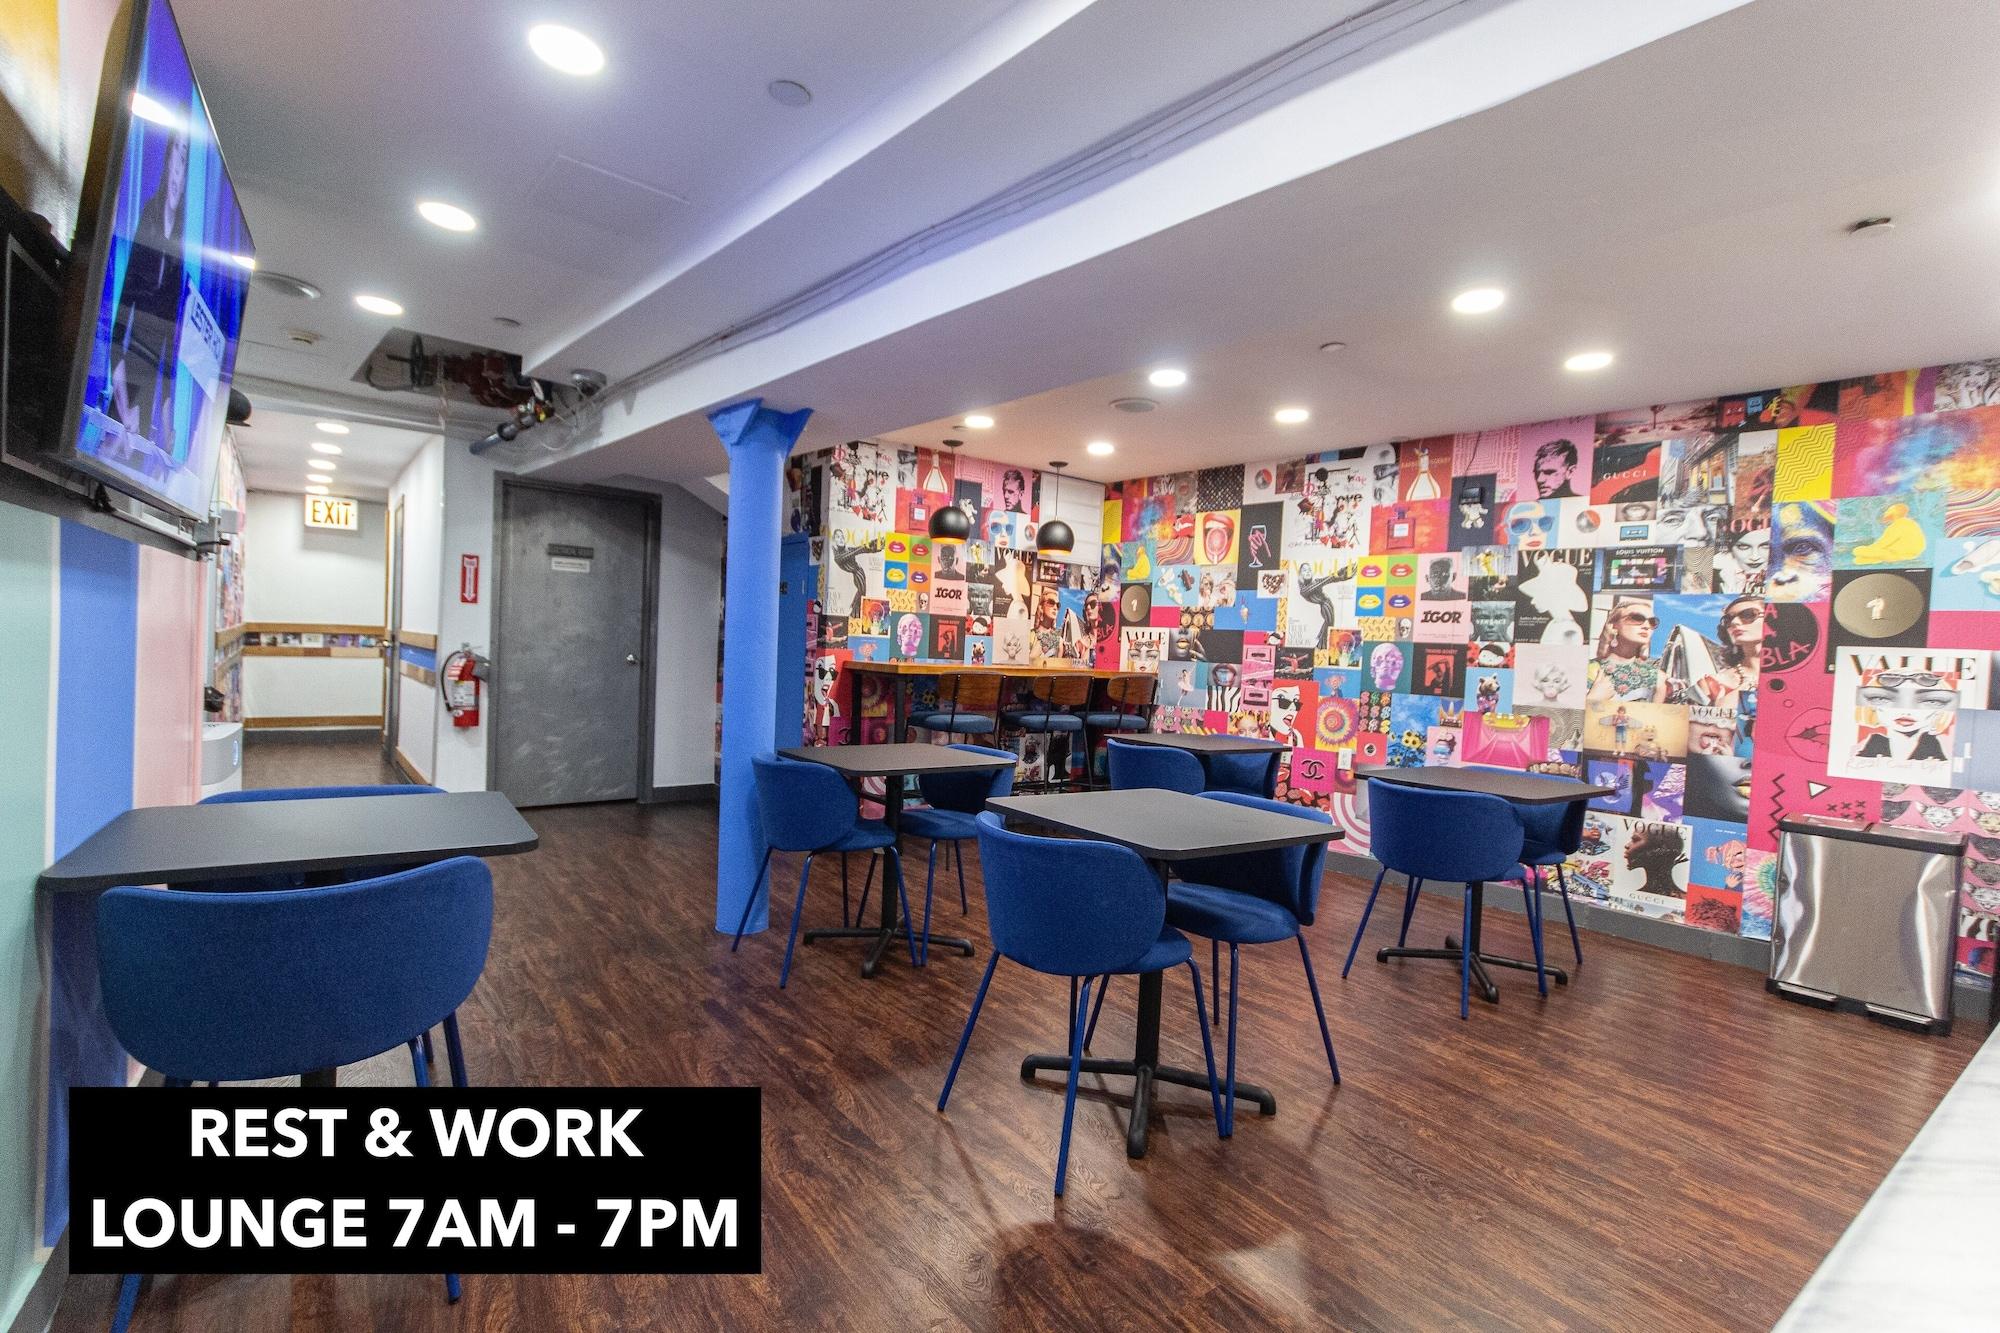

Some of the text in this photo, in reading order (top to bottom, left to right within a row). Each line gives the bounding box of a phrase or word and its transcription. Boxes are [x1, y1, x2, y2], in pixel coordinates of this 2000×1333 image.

[1602, 469, 1648, 481] GUCCI
[312, 499, 353, 525] EXIT
[1521, 547, 1593, 568] VOGUE
[1636, 547, 1665, 555] VUITTON
[935, 586, 962, 601] IGOR
[1420, 610, 1463, 624] IGOR
[1760, 640, 1811, 668] BLA
[1690, 705, 1737, 719] VOGUE
[1623, 818, 1689, 841] VOGUE
[1628, 892, 1665, 905] GUCCI
